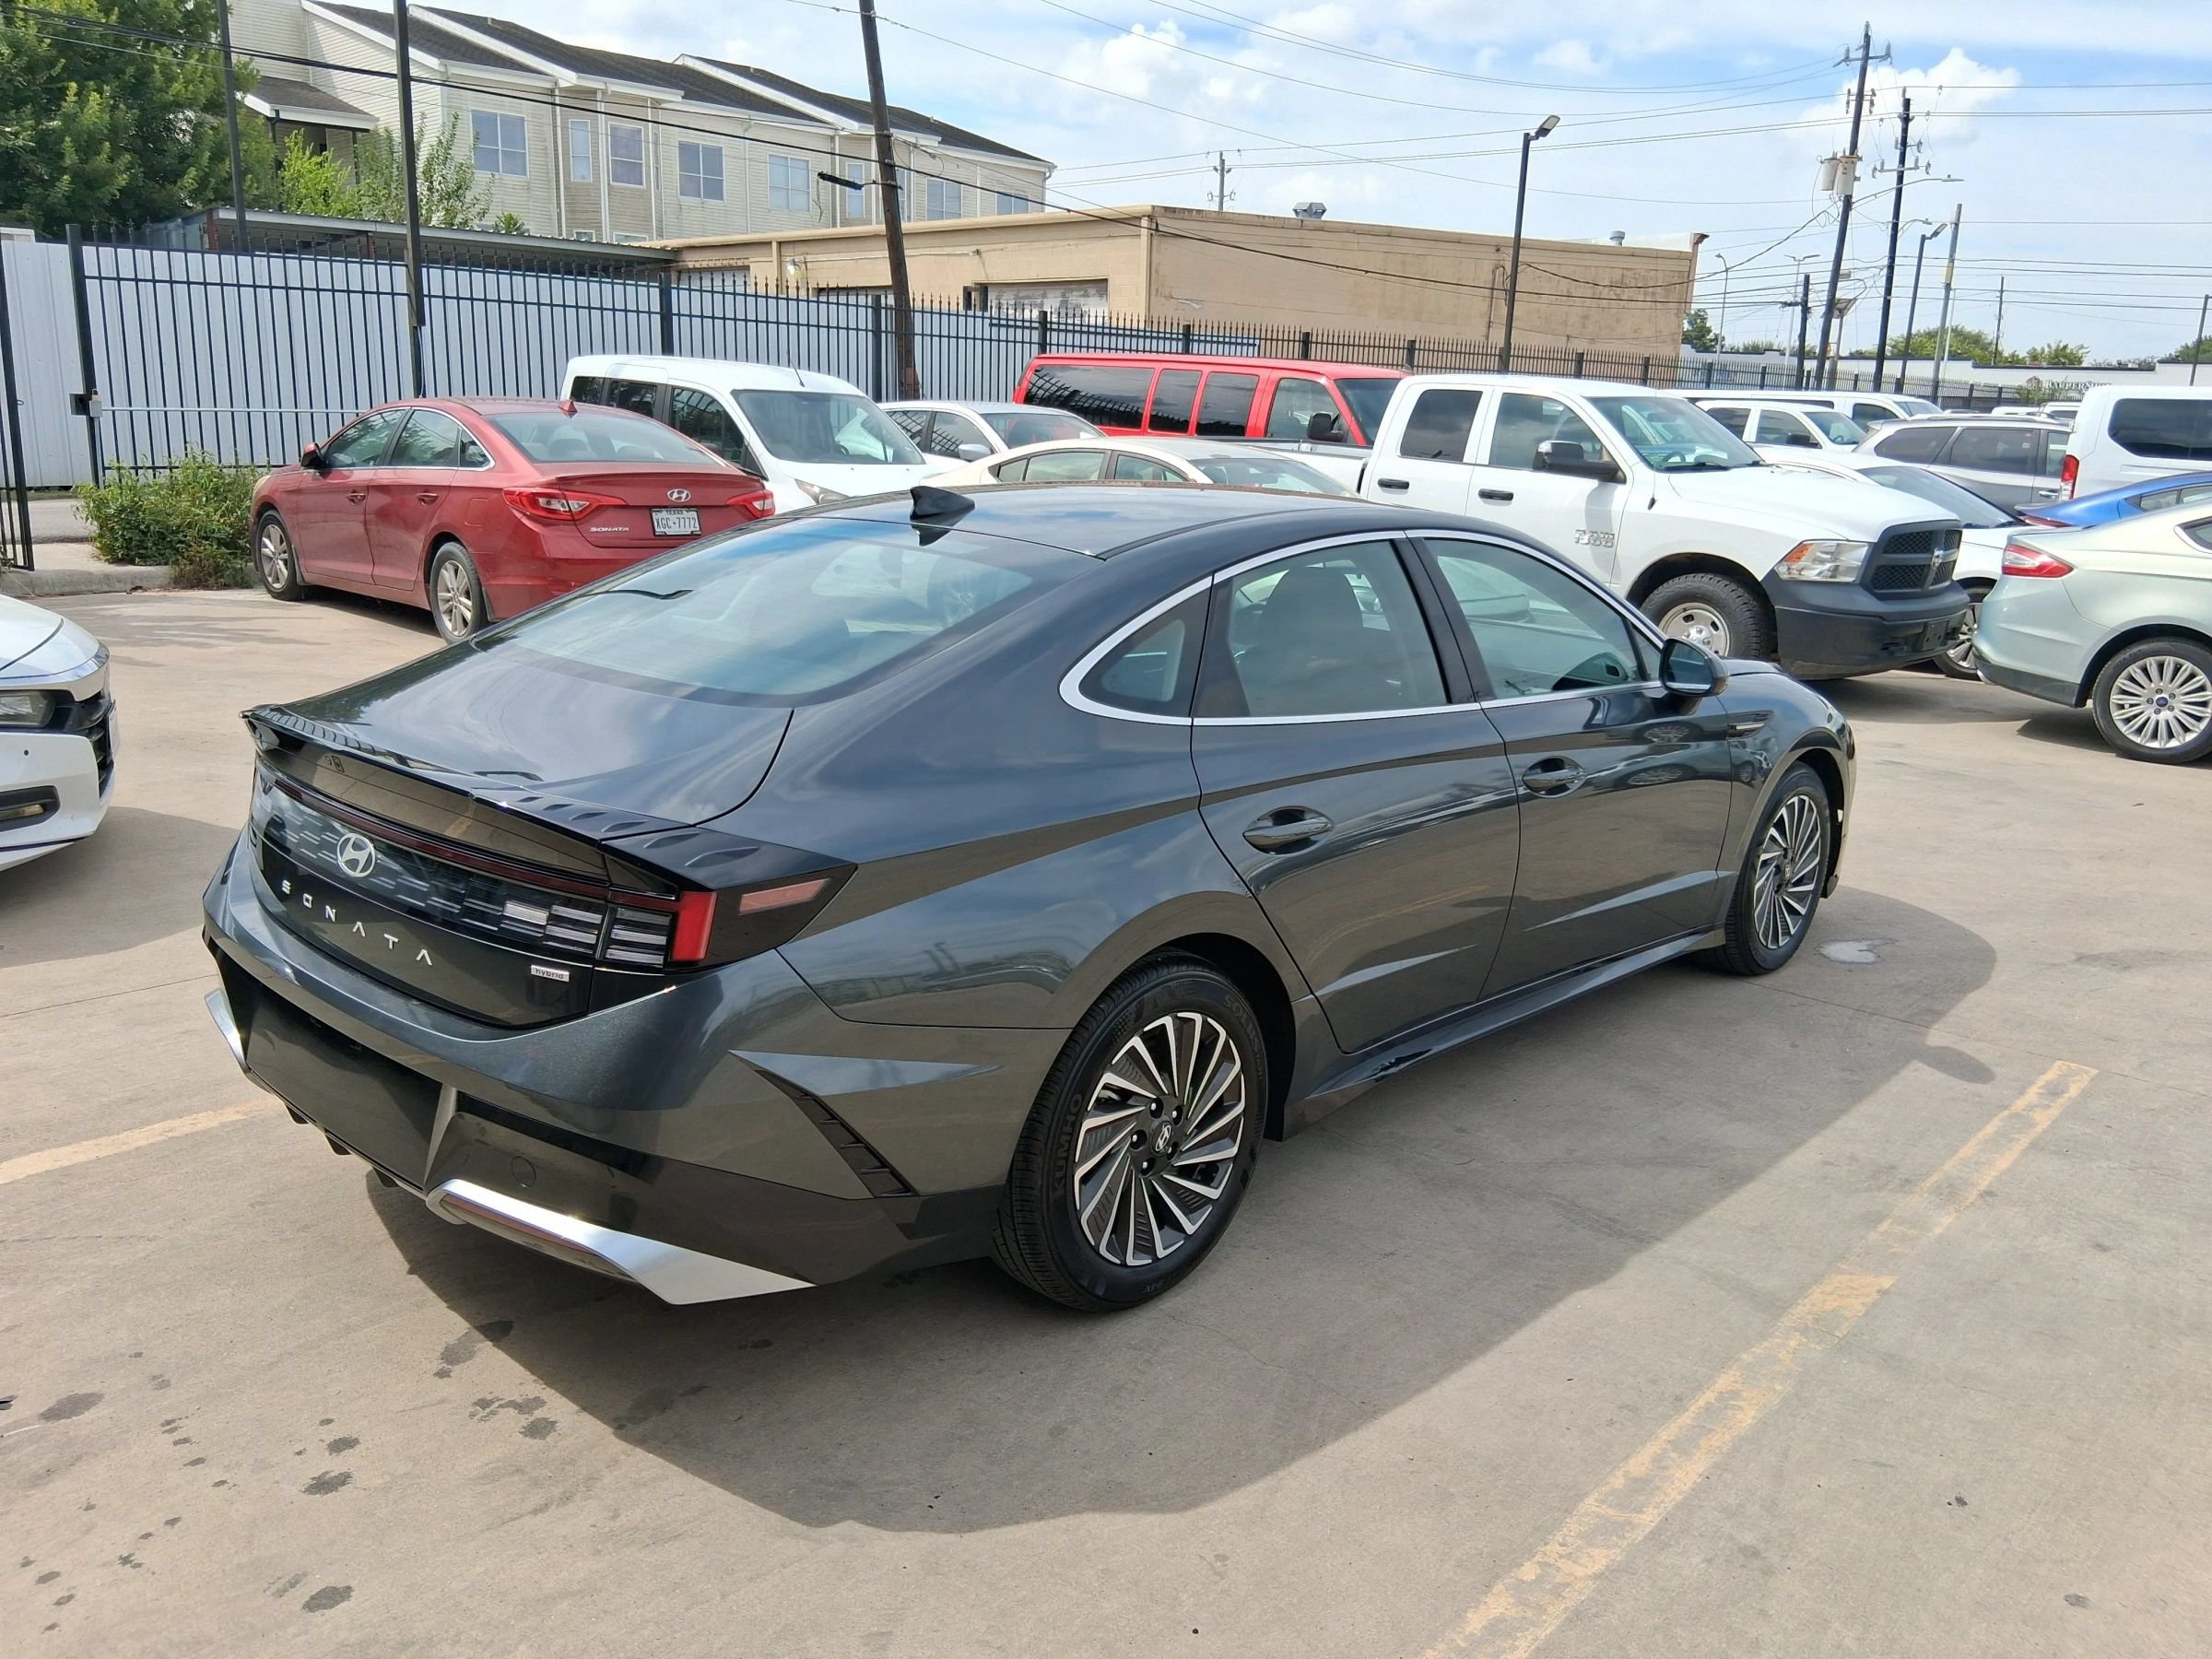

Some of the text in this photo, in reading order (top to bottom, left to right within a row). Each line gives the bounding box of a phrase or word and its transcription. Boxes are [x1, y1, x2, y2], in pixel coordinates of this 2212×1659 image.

[281, 879, 433, 966] SONATA
[535, 969, 564, 979] hybrid
[1053, 1093, 1083, 1195] KUMHO
